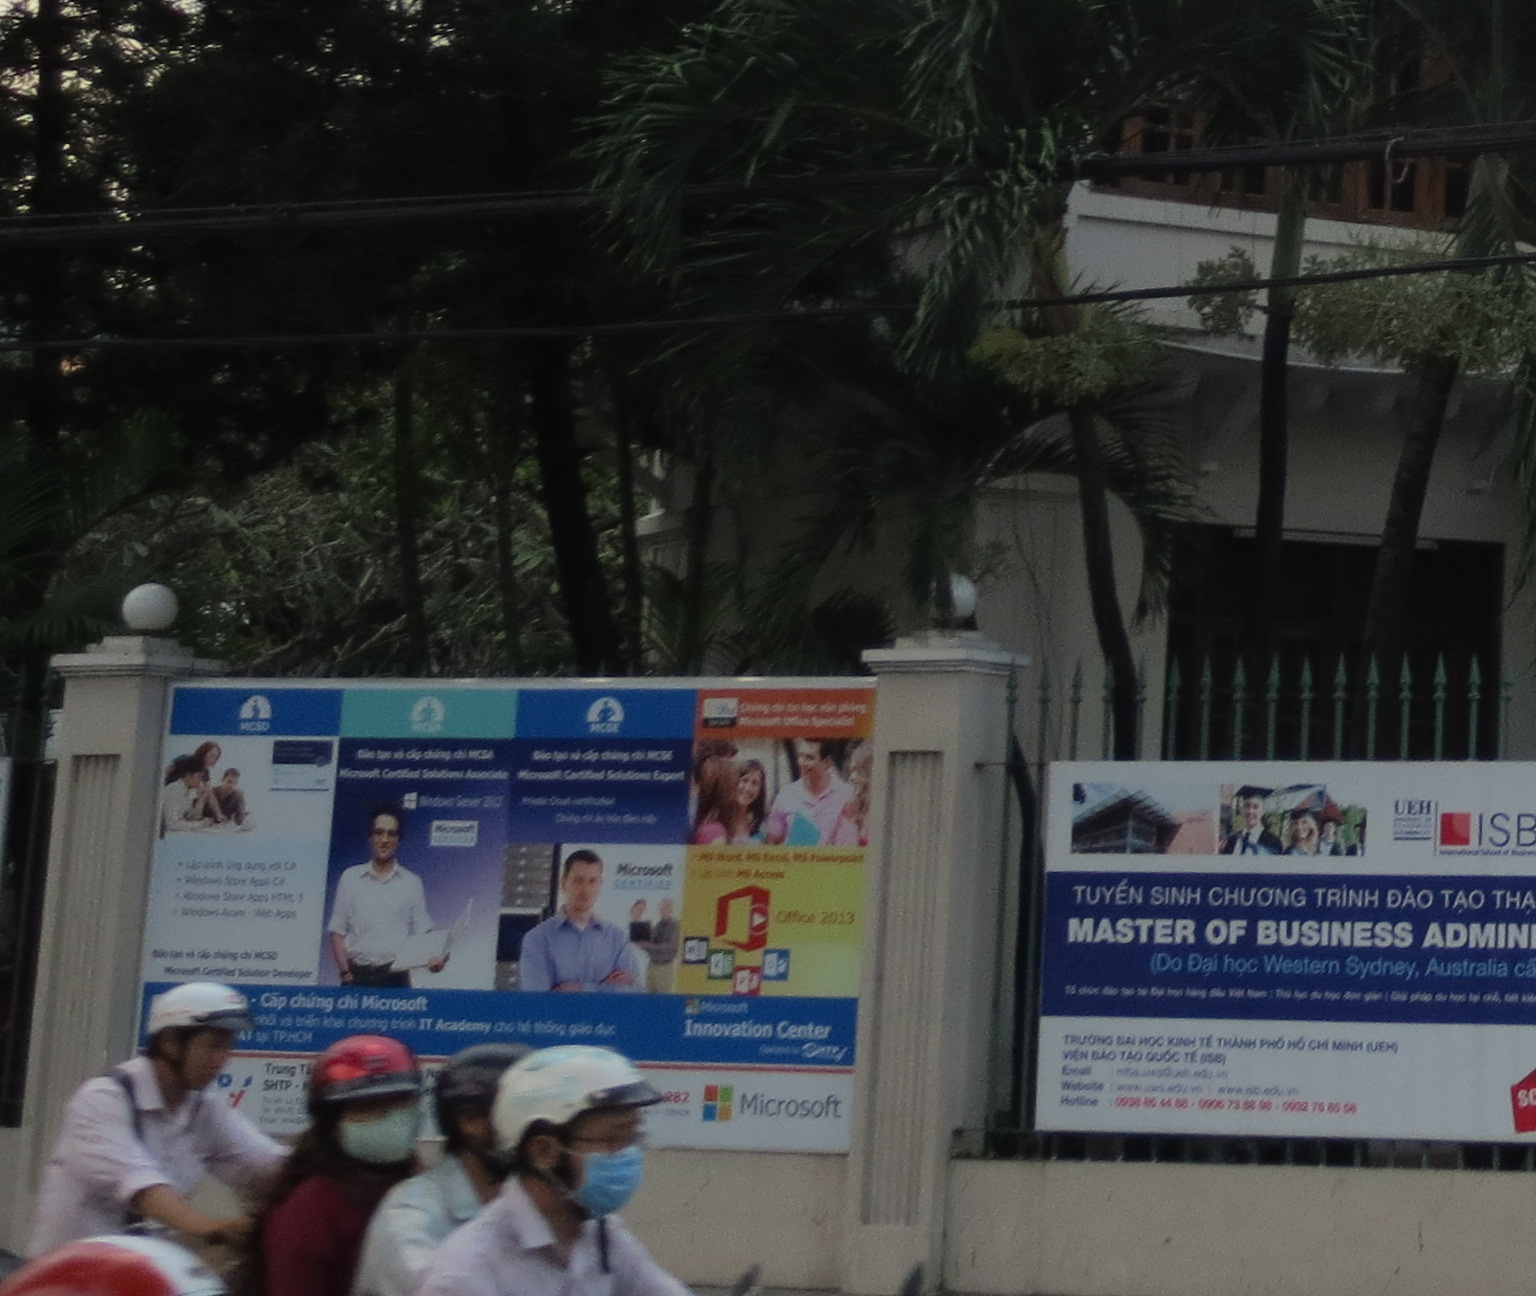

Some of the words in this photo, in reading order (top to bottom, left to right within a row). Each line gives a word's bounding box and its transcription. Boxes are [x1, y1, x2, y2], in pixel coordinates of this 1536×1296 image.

[617, 862, 674, 877] Microsoft
[1150, 887, 1200, 904] SINH
[1208, 887, 1307, 907] CHƯƠNG
[1314, 884, 1379, 908] TRÌNH
[1385, 885, 1432, 909] ĐÀO
[1440, 889, 1484, 913] TẠO
[777, 911, 817, 926] Office
[821, 911, 856, 926] 2013
[1068, 918, 1195, 944] MASTER
[1205, 920, 1248, 945] OF
[1256, 919, 1414, 949] BUSINESS
[1187, 954, 1219, 977] Đại
[1223, 956, 1257, 978] học
[1264, 956, 1340, 975] Western
[1425, 958, 1508, 978] Australia
[361, 996, 428, 1011] Microsoft
[418, 1018, 435, 1031] IT
[438, 1019, 490, 1033] Academy
[684, 1019, 773, 1039] Innovation
[776, 1020, 831, 1040] Center
[739, 1093, 842, 1119] Microsoft
